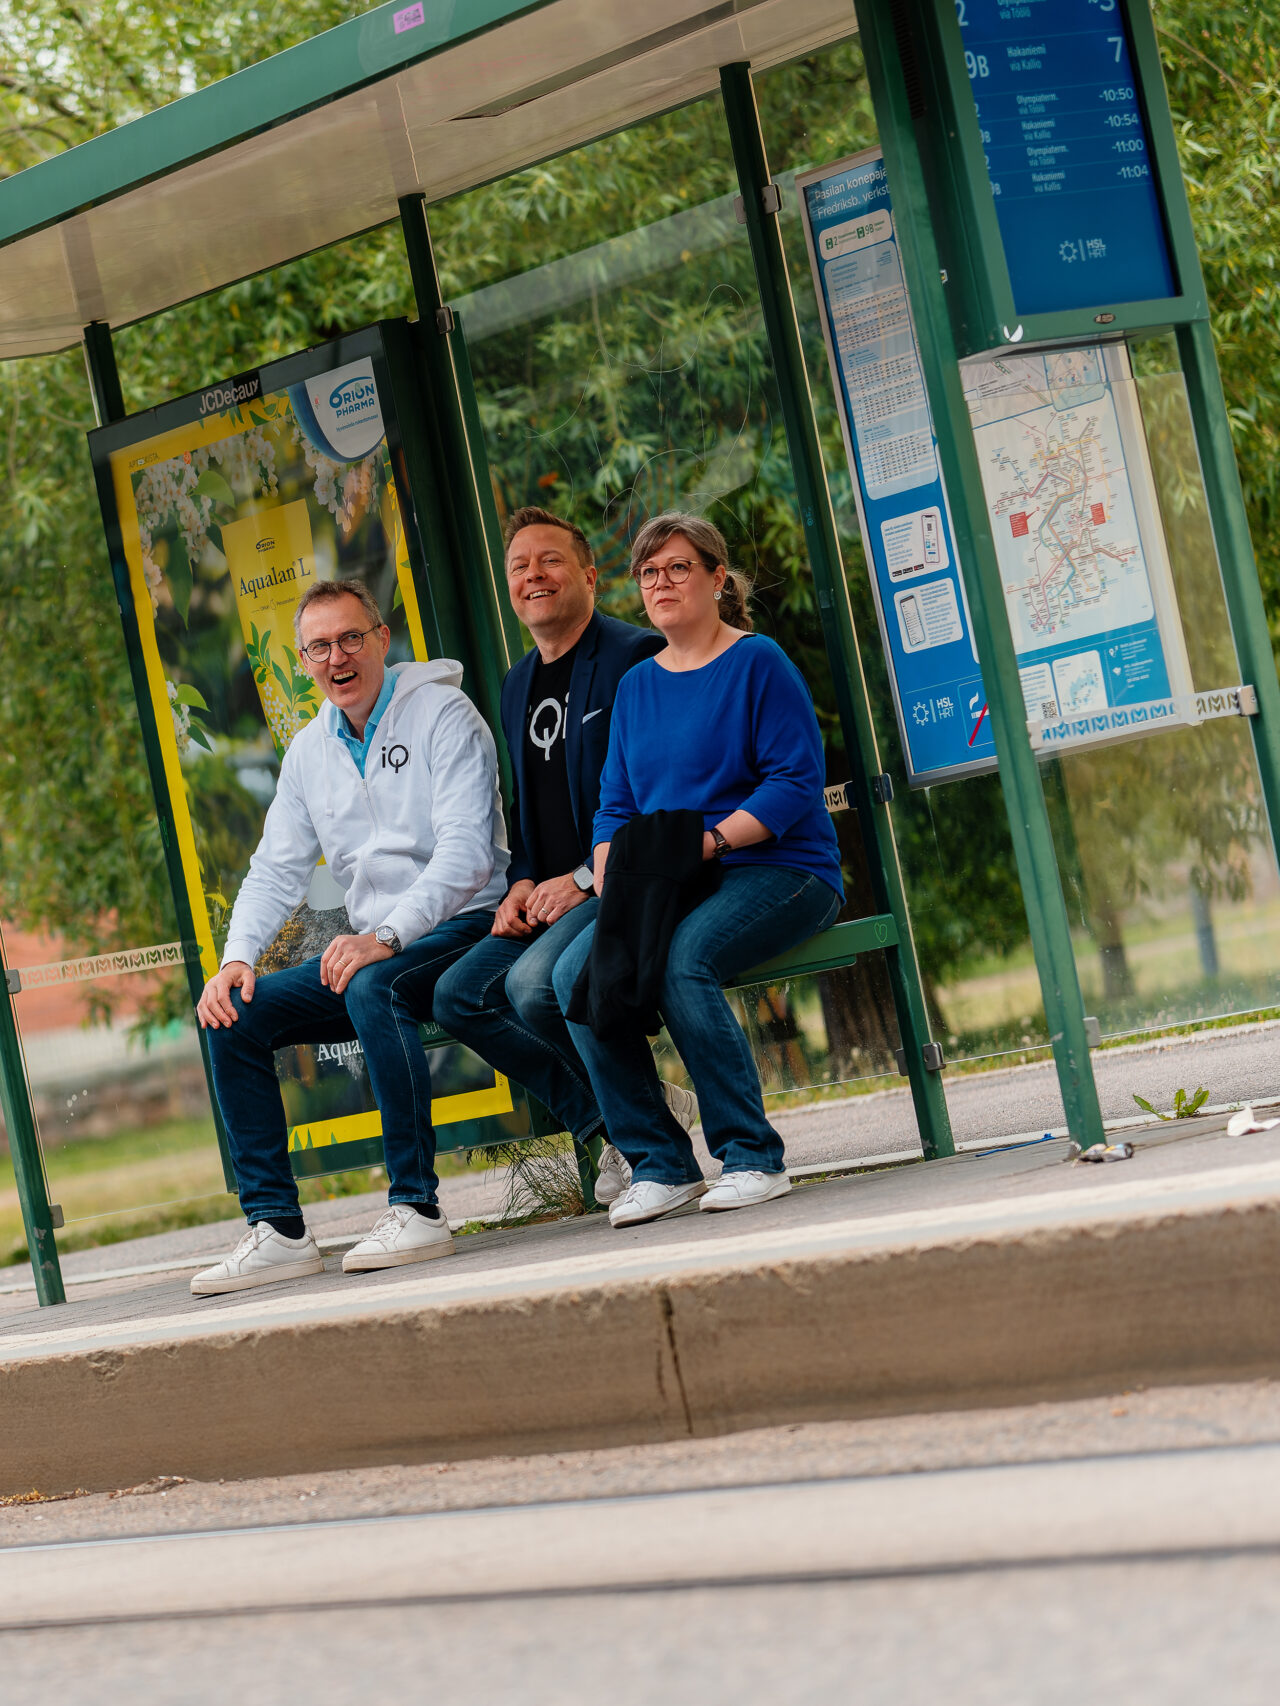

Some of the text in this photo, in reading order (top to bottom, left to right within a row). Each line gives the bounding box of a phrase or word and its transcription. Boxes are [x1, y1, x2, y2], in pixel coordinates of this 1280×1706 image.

[1107, 37, 1123, 63] 7
[964, 51, 990, 78] 9B
[814, 182, 846, 202] Pasilan
[862, 184, 890, 202] verkst
[199, 379, 259, 415] JCDecaux
[329, 376, 375, 409] ORION
[336, 397, 375, 419] PHARMA
[240, 557, 311, 599] Aqualan L
[936, 696, 954, 709] HSL
[938, 706, 954, 719] HRT
[317, 1040, 364, 1067] Aqua
